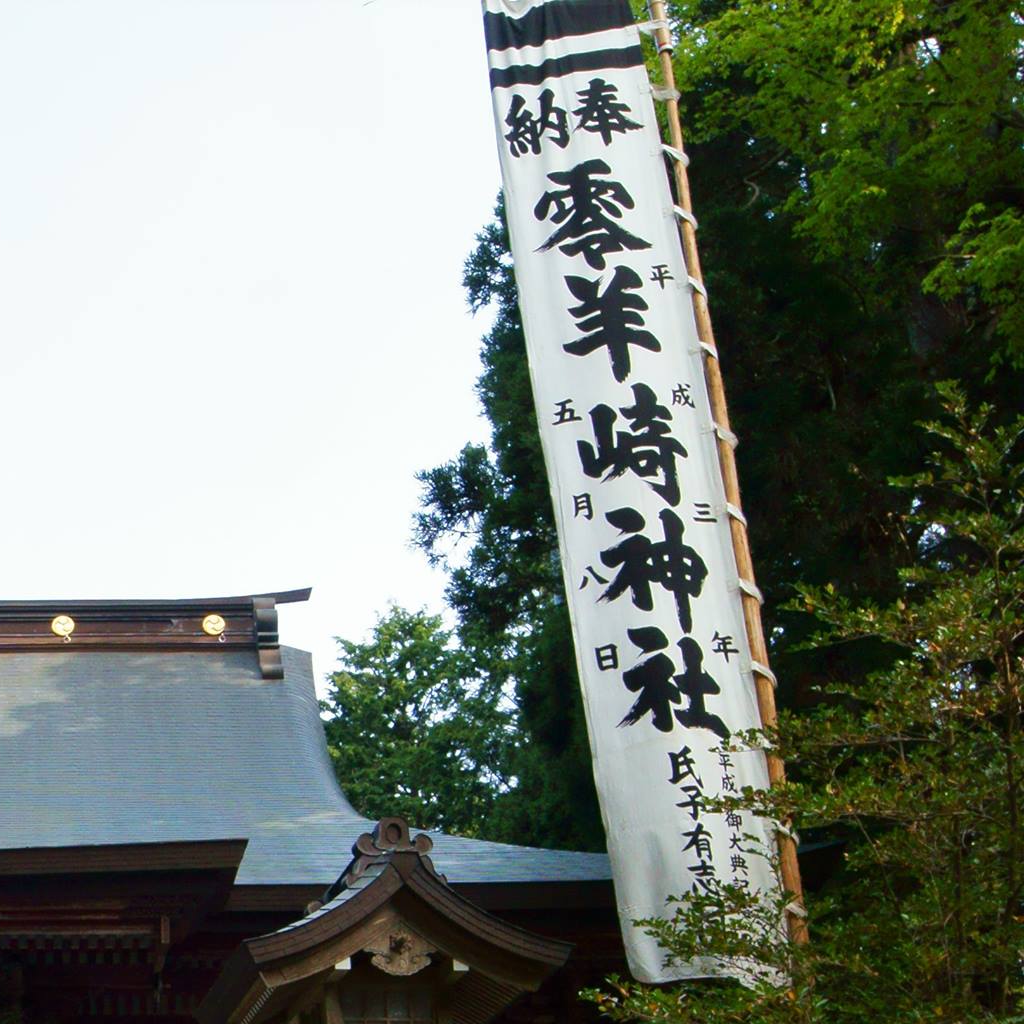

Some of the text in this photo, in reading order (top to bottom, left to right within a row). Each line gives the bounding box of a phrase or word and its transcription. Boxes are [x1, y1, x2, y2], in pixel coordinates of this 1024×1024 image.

[503, 78, 644, 158] 奉納
[533, 159, 731, 739] 零羊崎神社
[666, 745, 726, 944] 氏子有志
